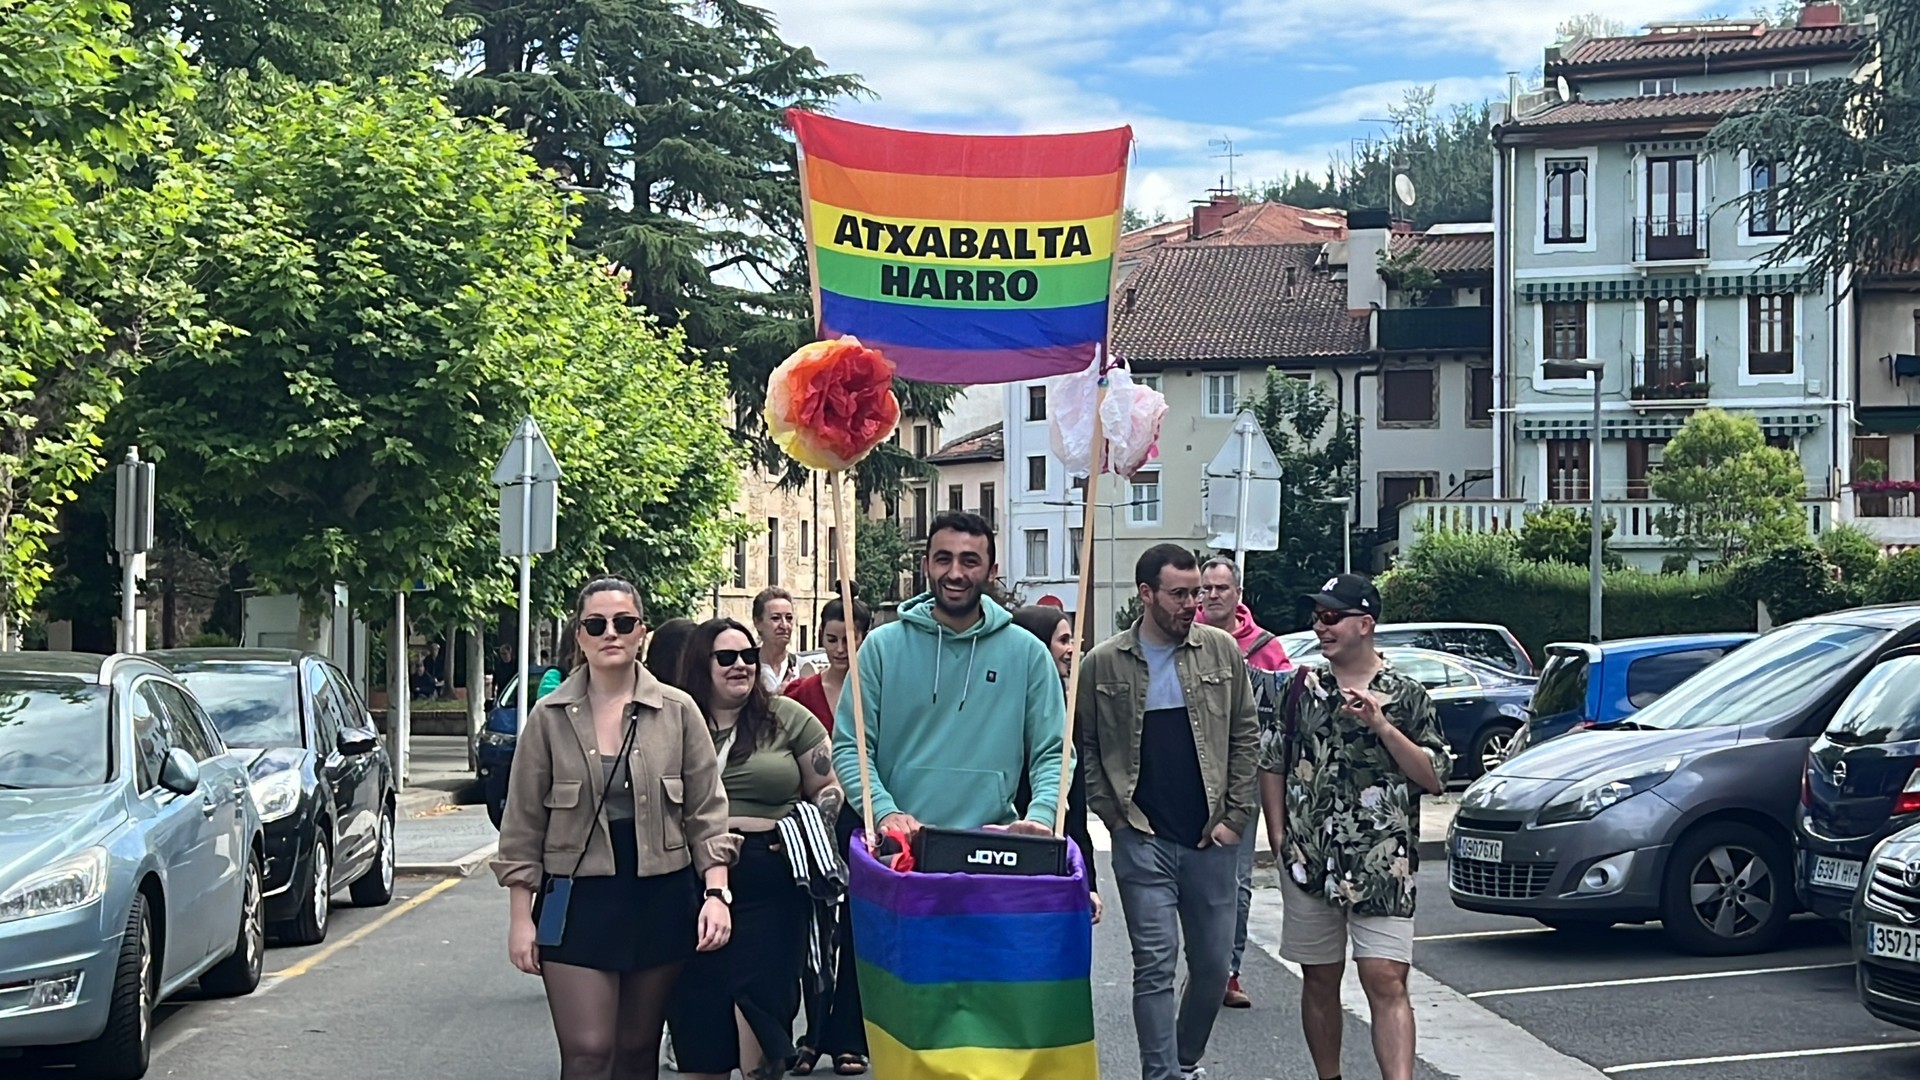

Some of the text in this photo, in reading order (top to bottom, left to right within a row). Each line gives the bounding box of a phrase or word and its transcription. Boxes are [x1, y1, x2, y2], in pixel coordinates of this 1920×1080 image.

[834, 214, 1092, 259] ATXABALTA
[881, 264, 1038, 301] HARRO
[967, 849, 1017, 866] JOYO
[1817, 859, 1840, 881] 6391
[1876, 927, 1912, 957] 3572
